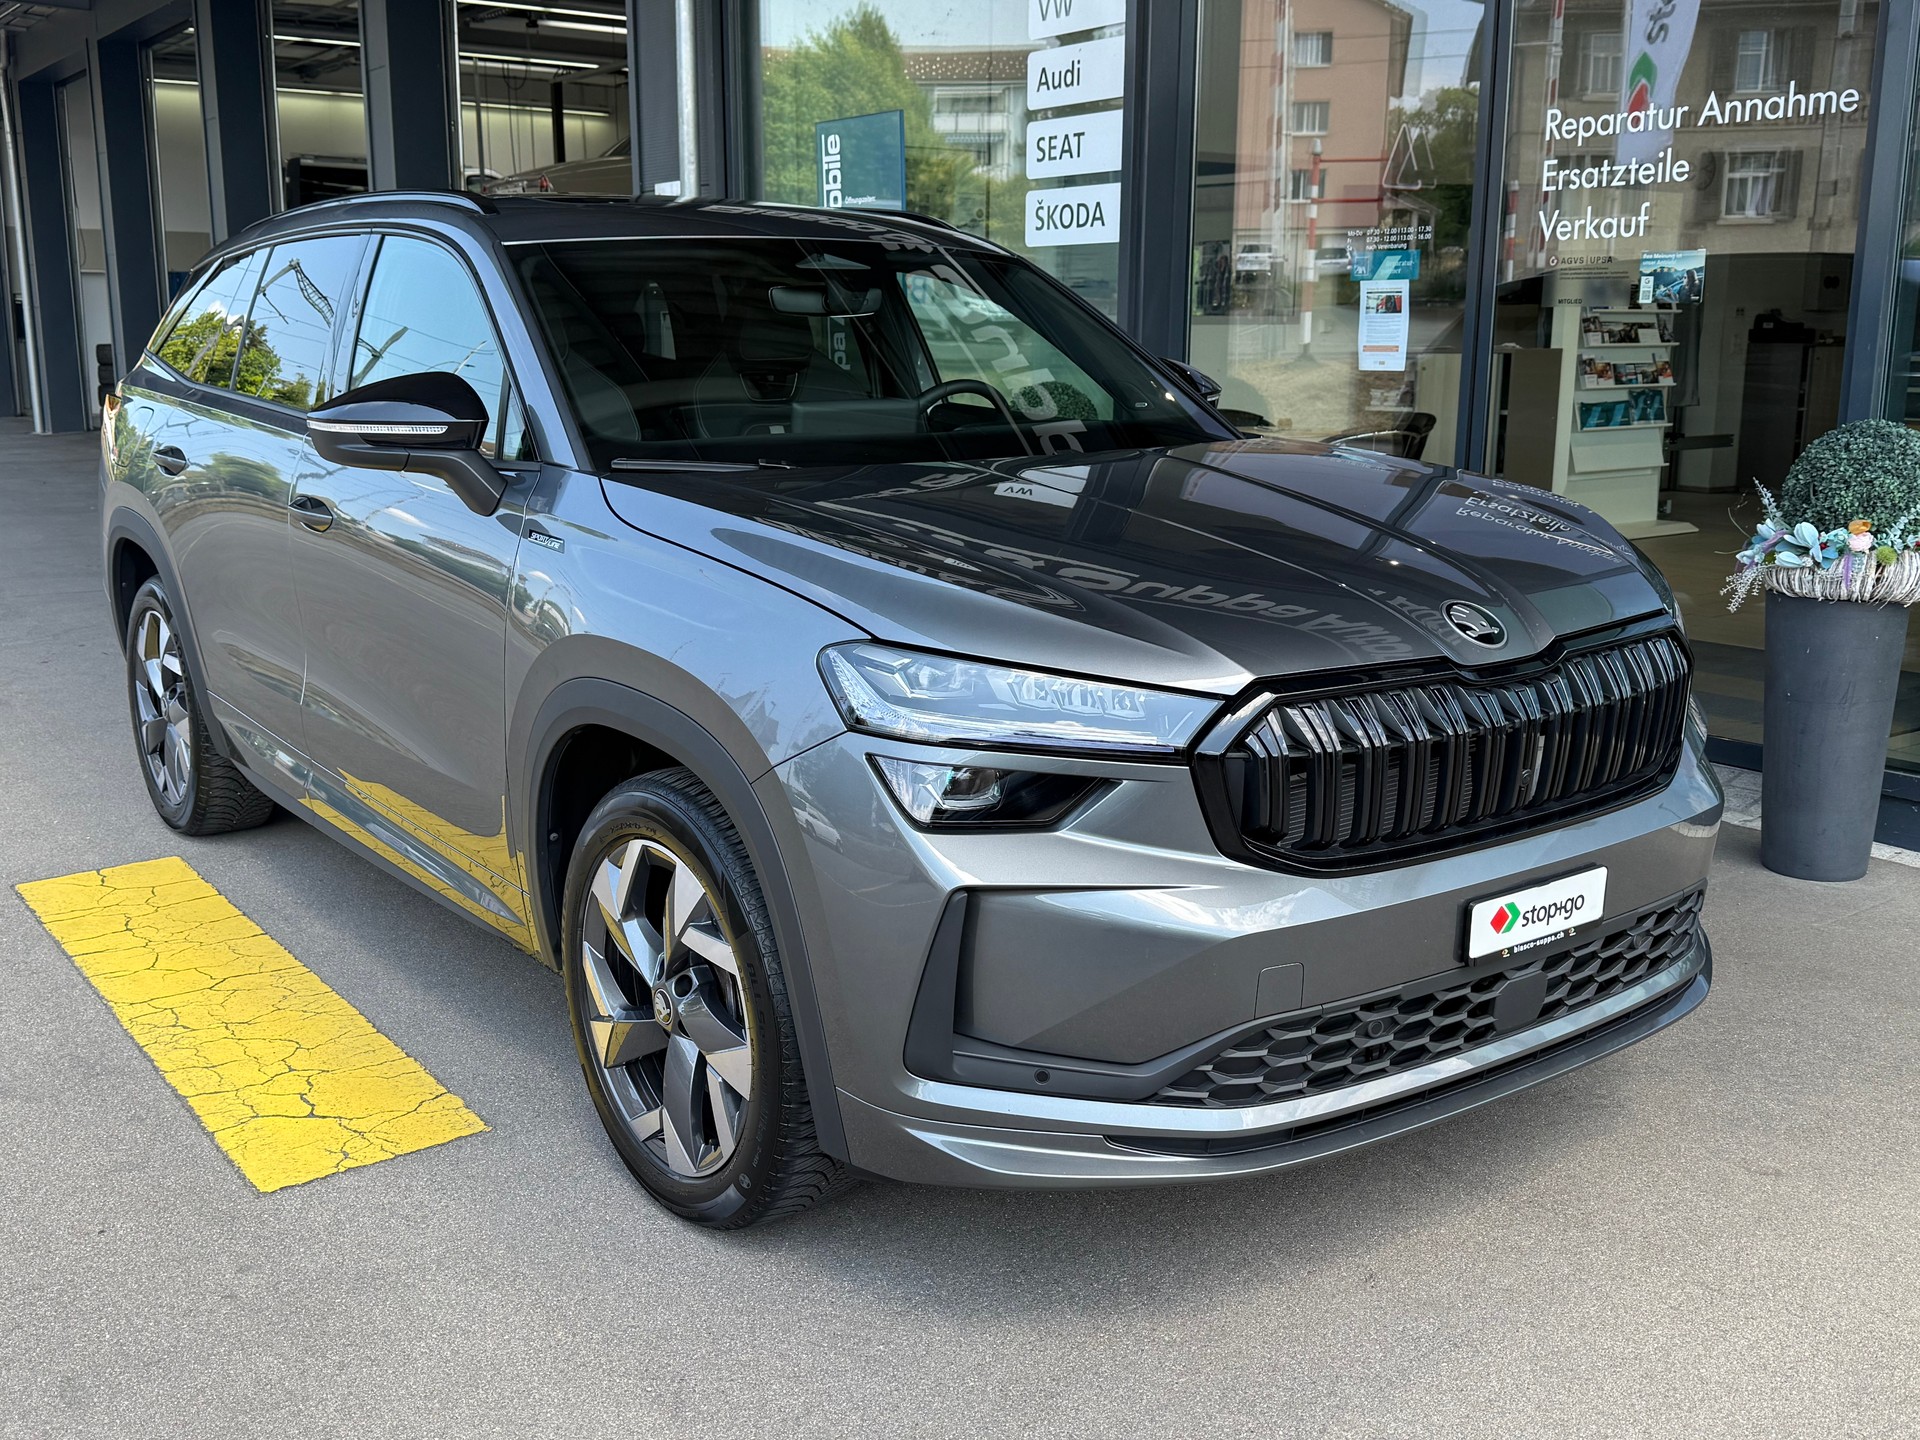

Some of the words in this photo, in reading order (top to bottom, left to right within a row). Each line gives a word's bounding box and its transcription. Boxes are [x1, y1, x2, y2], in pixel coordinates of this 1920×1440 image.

[1037, 0, 1073, 22] VW
[1036, 59, 1081, 93] Audi
[1545, 103, 1689, 147] Reparatur
[1698, 80, 1860, 127] Annahme
[1036, 131, 1086, 163] SEAT
[1541, 148, 1690, 192] Ersatzteile
[1034, 199, 1106, 232] ŠKODA
[1538, 202, 1651, 243] Verkauf
[1561, 256, 1585, 265] AGVS
[1590, 256, 1613, 264] UPSA
[1521, 894, 1585, 928] stop+go
[1513, 931, 1565, 953] biasco-suppa.ch
